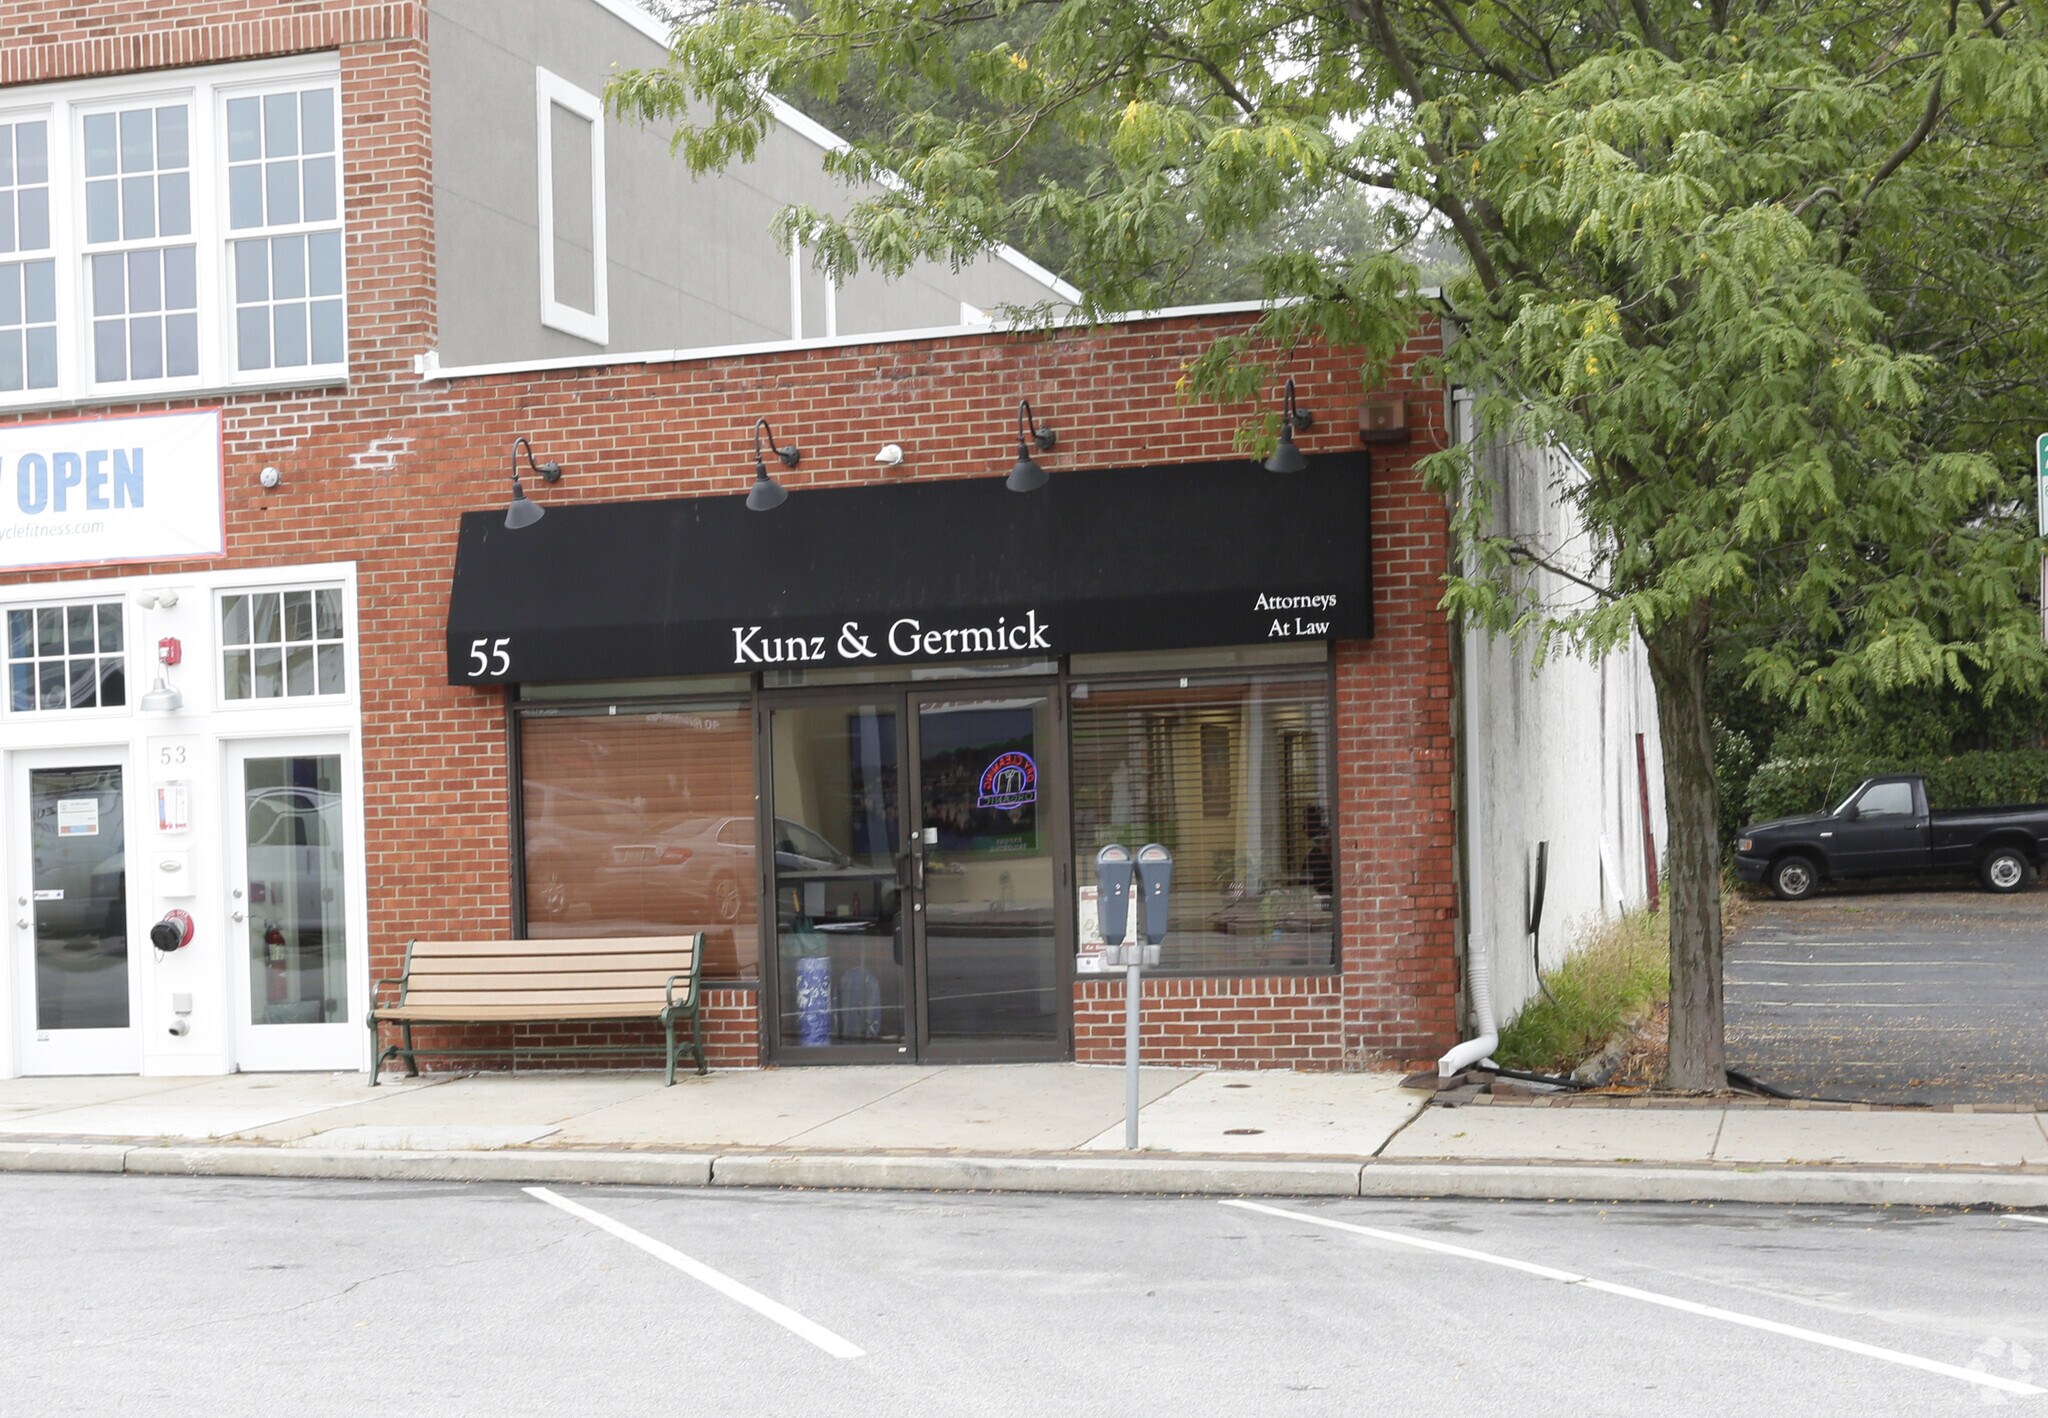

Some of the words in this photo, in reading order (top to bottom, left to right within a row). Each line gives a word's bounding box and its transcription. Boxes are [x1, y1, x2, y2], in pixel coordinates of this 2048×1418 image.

[17, 446, 145, 515] OPEN
[1255, 593, 1336, 611] Attorneys
[731, 625, 826, 664] Kunz
[837, 621, 878, 659] &
[888, 609, 1052, 657] Germick
[1267, 618, 1291, 637] At
[1294, 617, 1330, 637] Law
[467, 637, 511, 677] 55
[161, 746, 186, 764] 53
